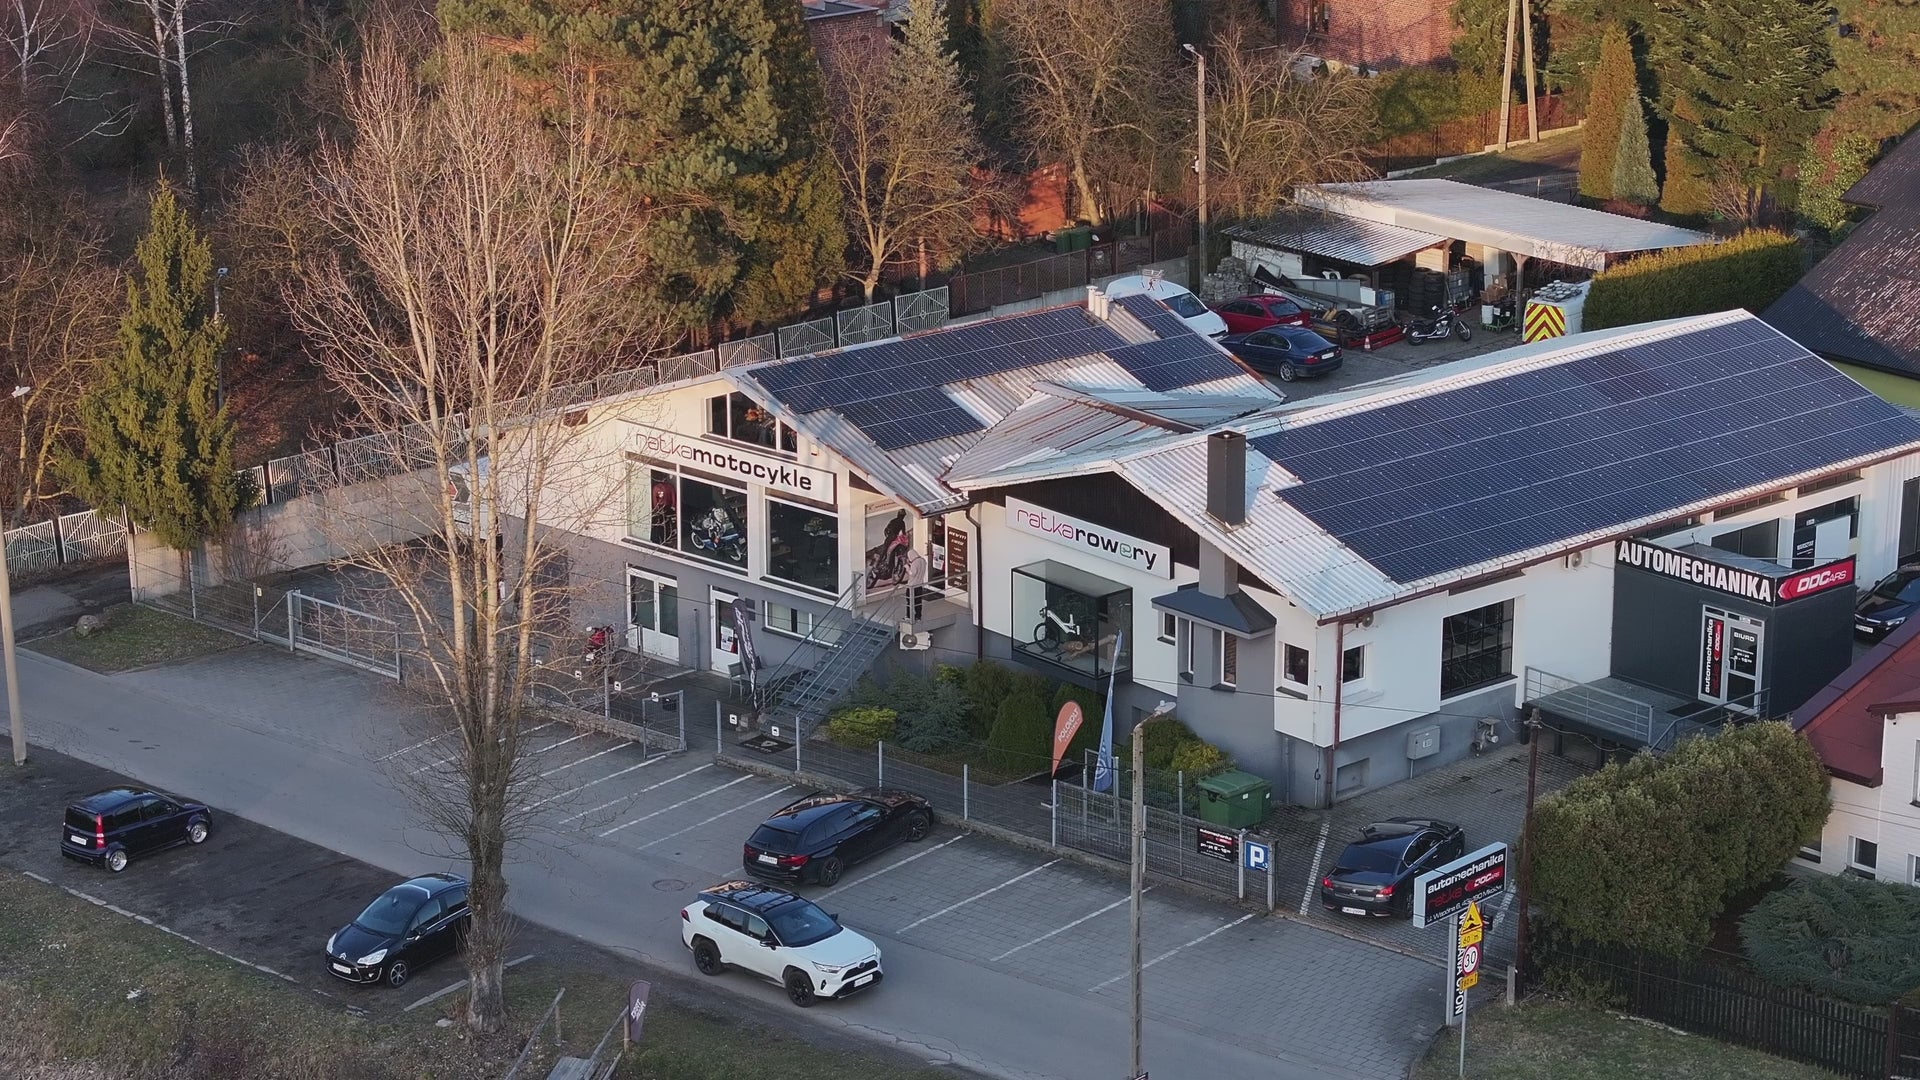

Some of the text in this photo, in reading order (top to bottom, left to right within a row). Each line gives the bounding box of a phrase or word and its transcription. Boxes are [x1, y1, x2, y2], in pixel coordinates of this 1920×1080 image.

[636, 433, 812, 490] ratkamotocykle
[1017, 509, 1157, 570] ratkarowery
[1618, 541, 1771, 602] AUTOMECHANIKA
[1705, 619, 1714, 693] automechanika
[1733, 632, 1755, 642] BIURO
[1250, 845, 1265, 867] P
[1427, 853, 1504, 894] automechanika
[1464, 950, 1476, 968] 30
